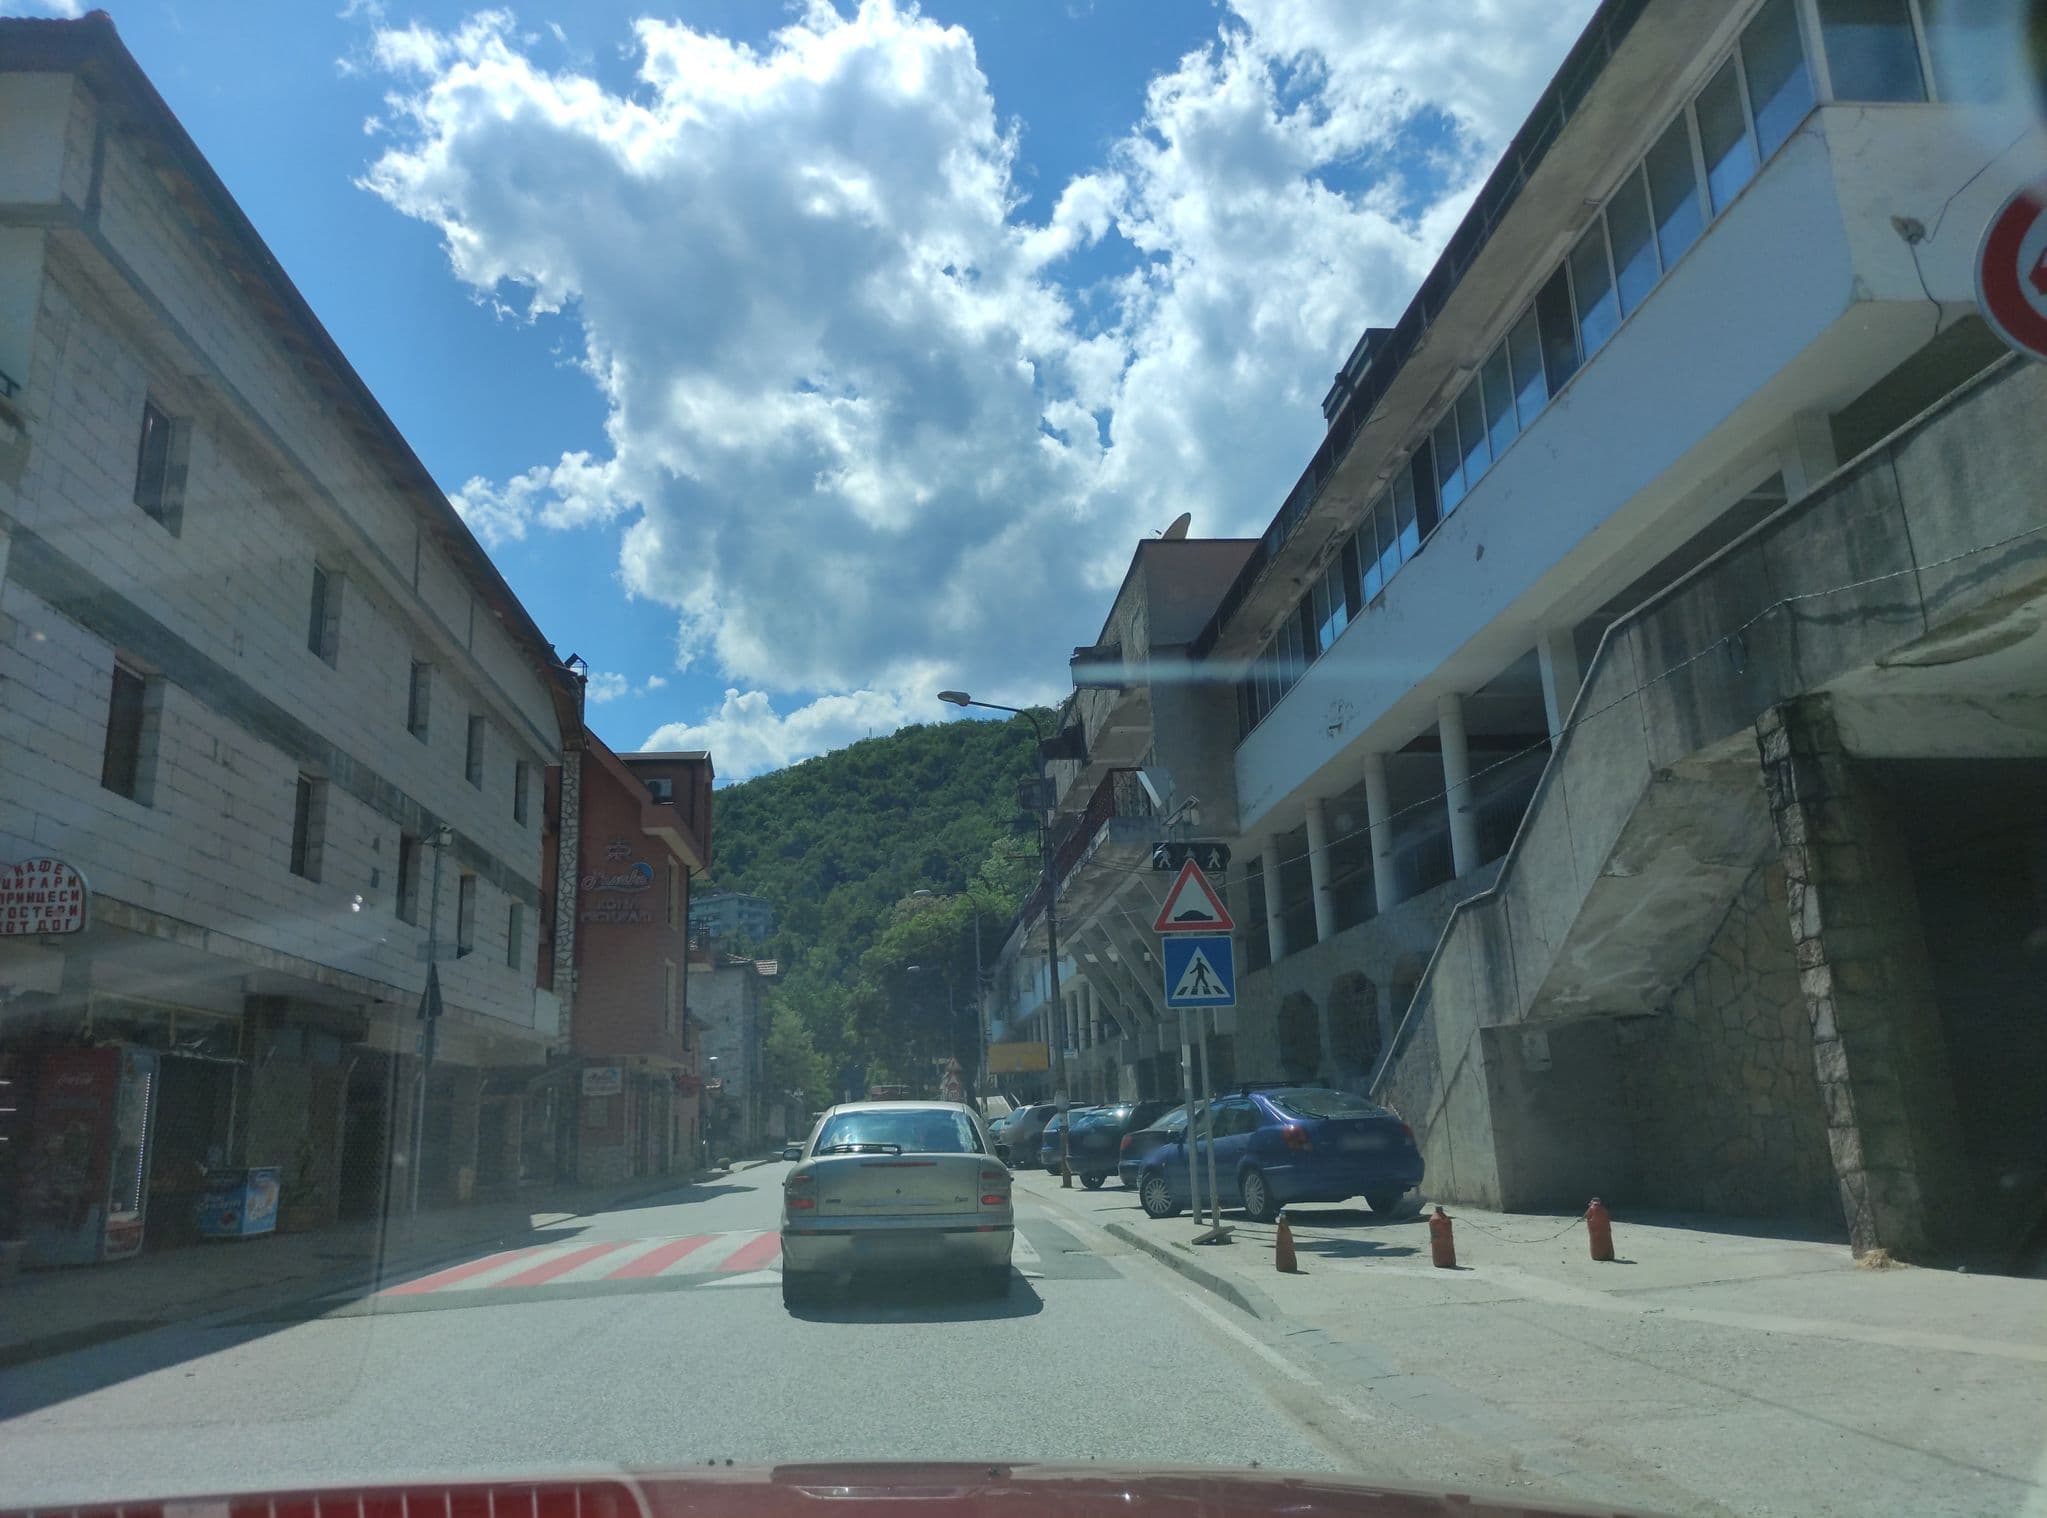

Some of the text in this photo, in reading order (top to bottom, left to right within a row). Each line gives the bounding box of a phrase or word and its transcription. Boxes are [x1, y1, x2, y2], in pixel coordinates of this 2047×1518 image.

[14, 860, 65, 876] КАФЕ
[2, 875, 77, 889] ЦИГАРИ
[0, 918, 72, 933] ОТ ДОГ
